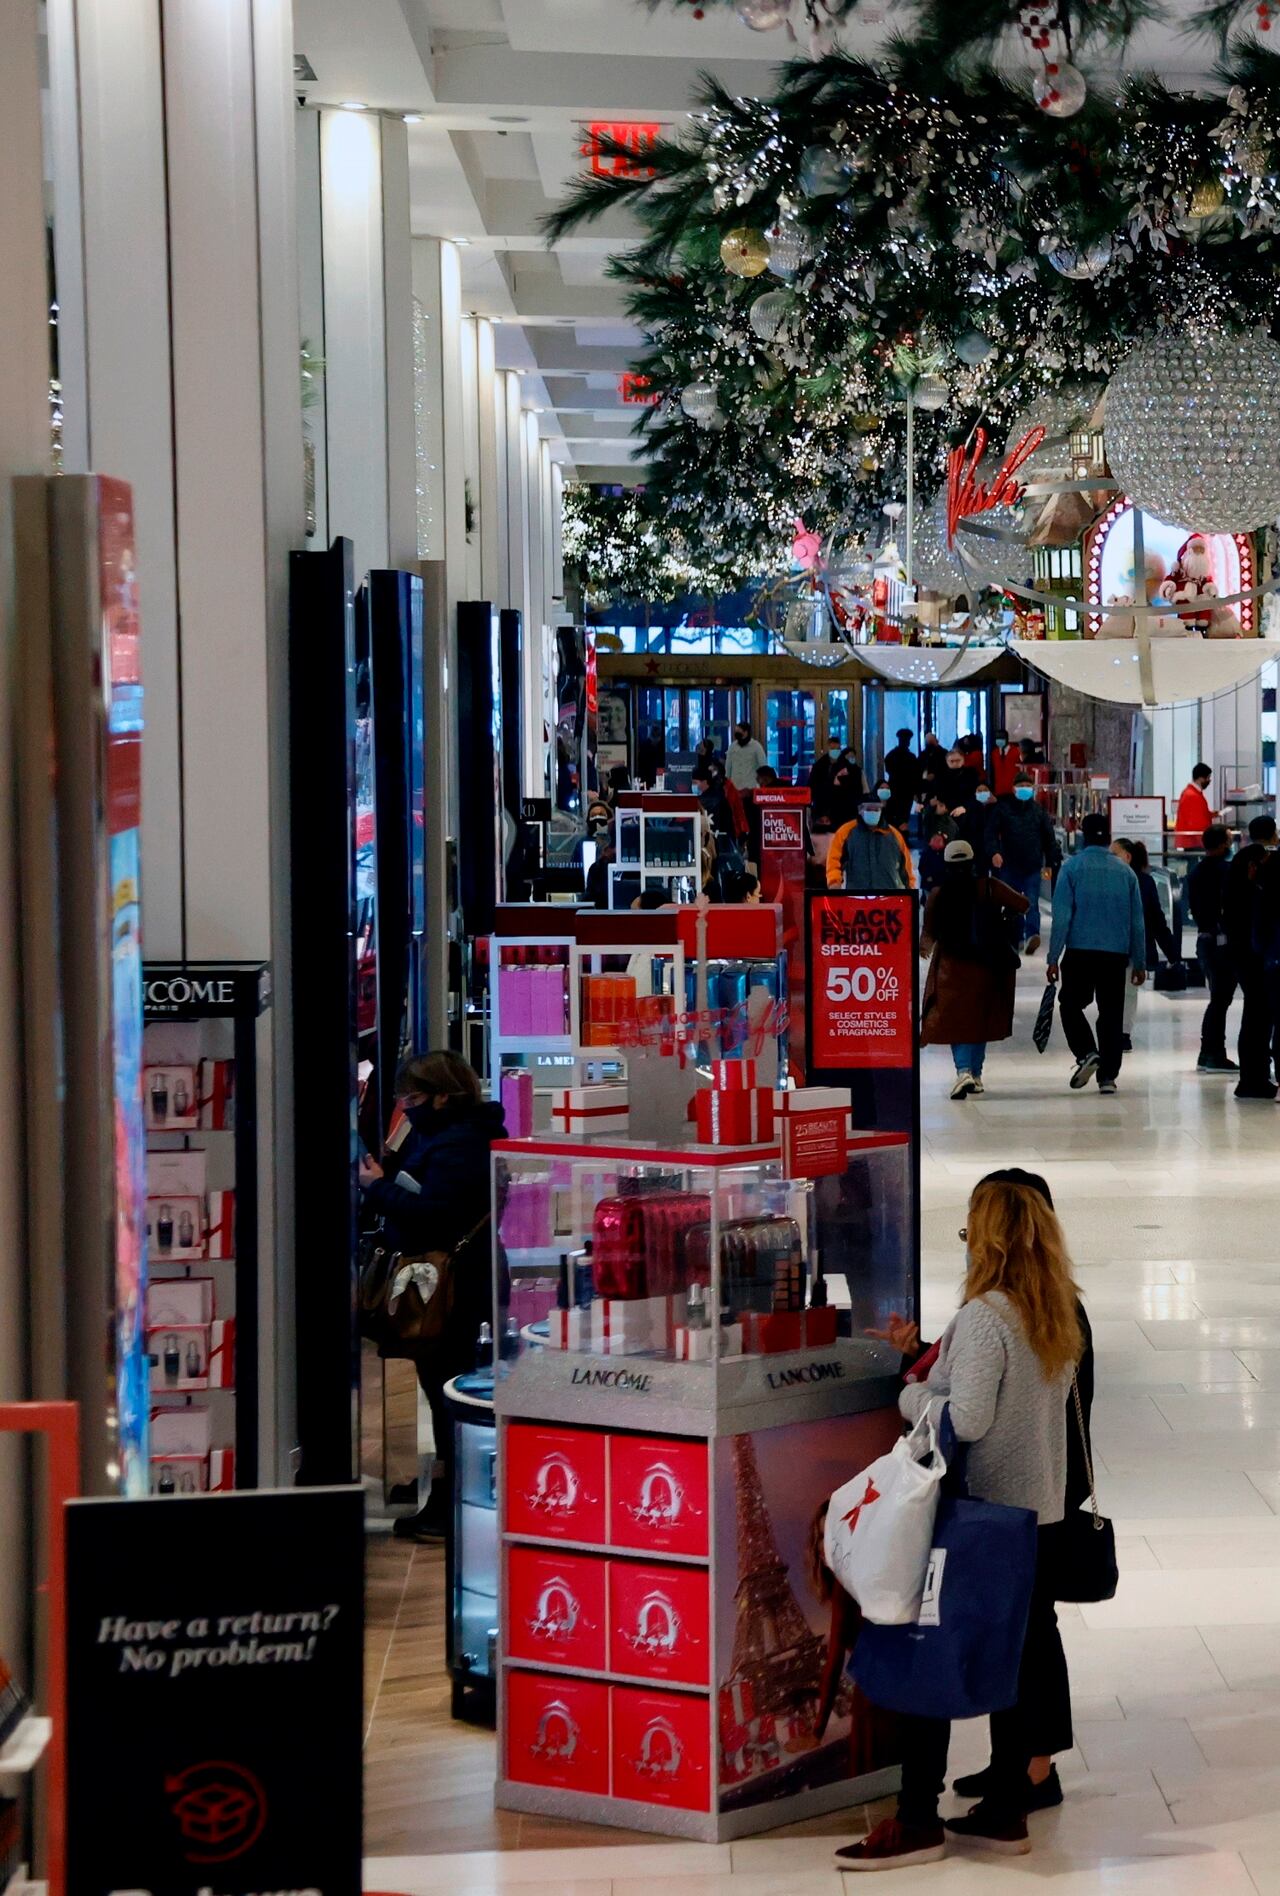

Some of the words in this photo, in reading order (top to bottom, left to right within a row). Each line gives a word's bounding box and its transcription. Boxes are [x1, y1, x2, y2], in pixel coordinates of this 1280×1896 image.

[755, 794, 785, 802] SPECIAL
[820, 908, 903, 928] BLACK
[820, 927, 902, 945] FRIDAY
[820, 944, 883, 957] SPECIAL
[876, 988, 899, 1002] OFF
[828, 1011, 862, 1020] SELECT
[863, 1011, 897, 1020] STYLES
[836, 1020, 889, 1028] COSMETICS
[828, 1028, 836, 1036] &
[837, 1028, 897, 1036] FRAGRANCES
[537, 1056, 552, 1065] LA
[571, 1367, 653, 1392] LANCÔME
[766, 1361, 846, 1390] LANCÔME
[97, 1615, 182, 1643] Have
[186, 1617, 209, 1638] a
[217, 1603, 341, 1636] return?
[119, 1644, 168, 1673] No
[169, 1635, 318, 1678] problem!
